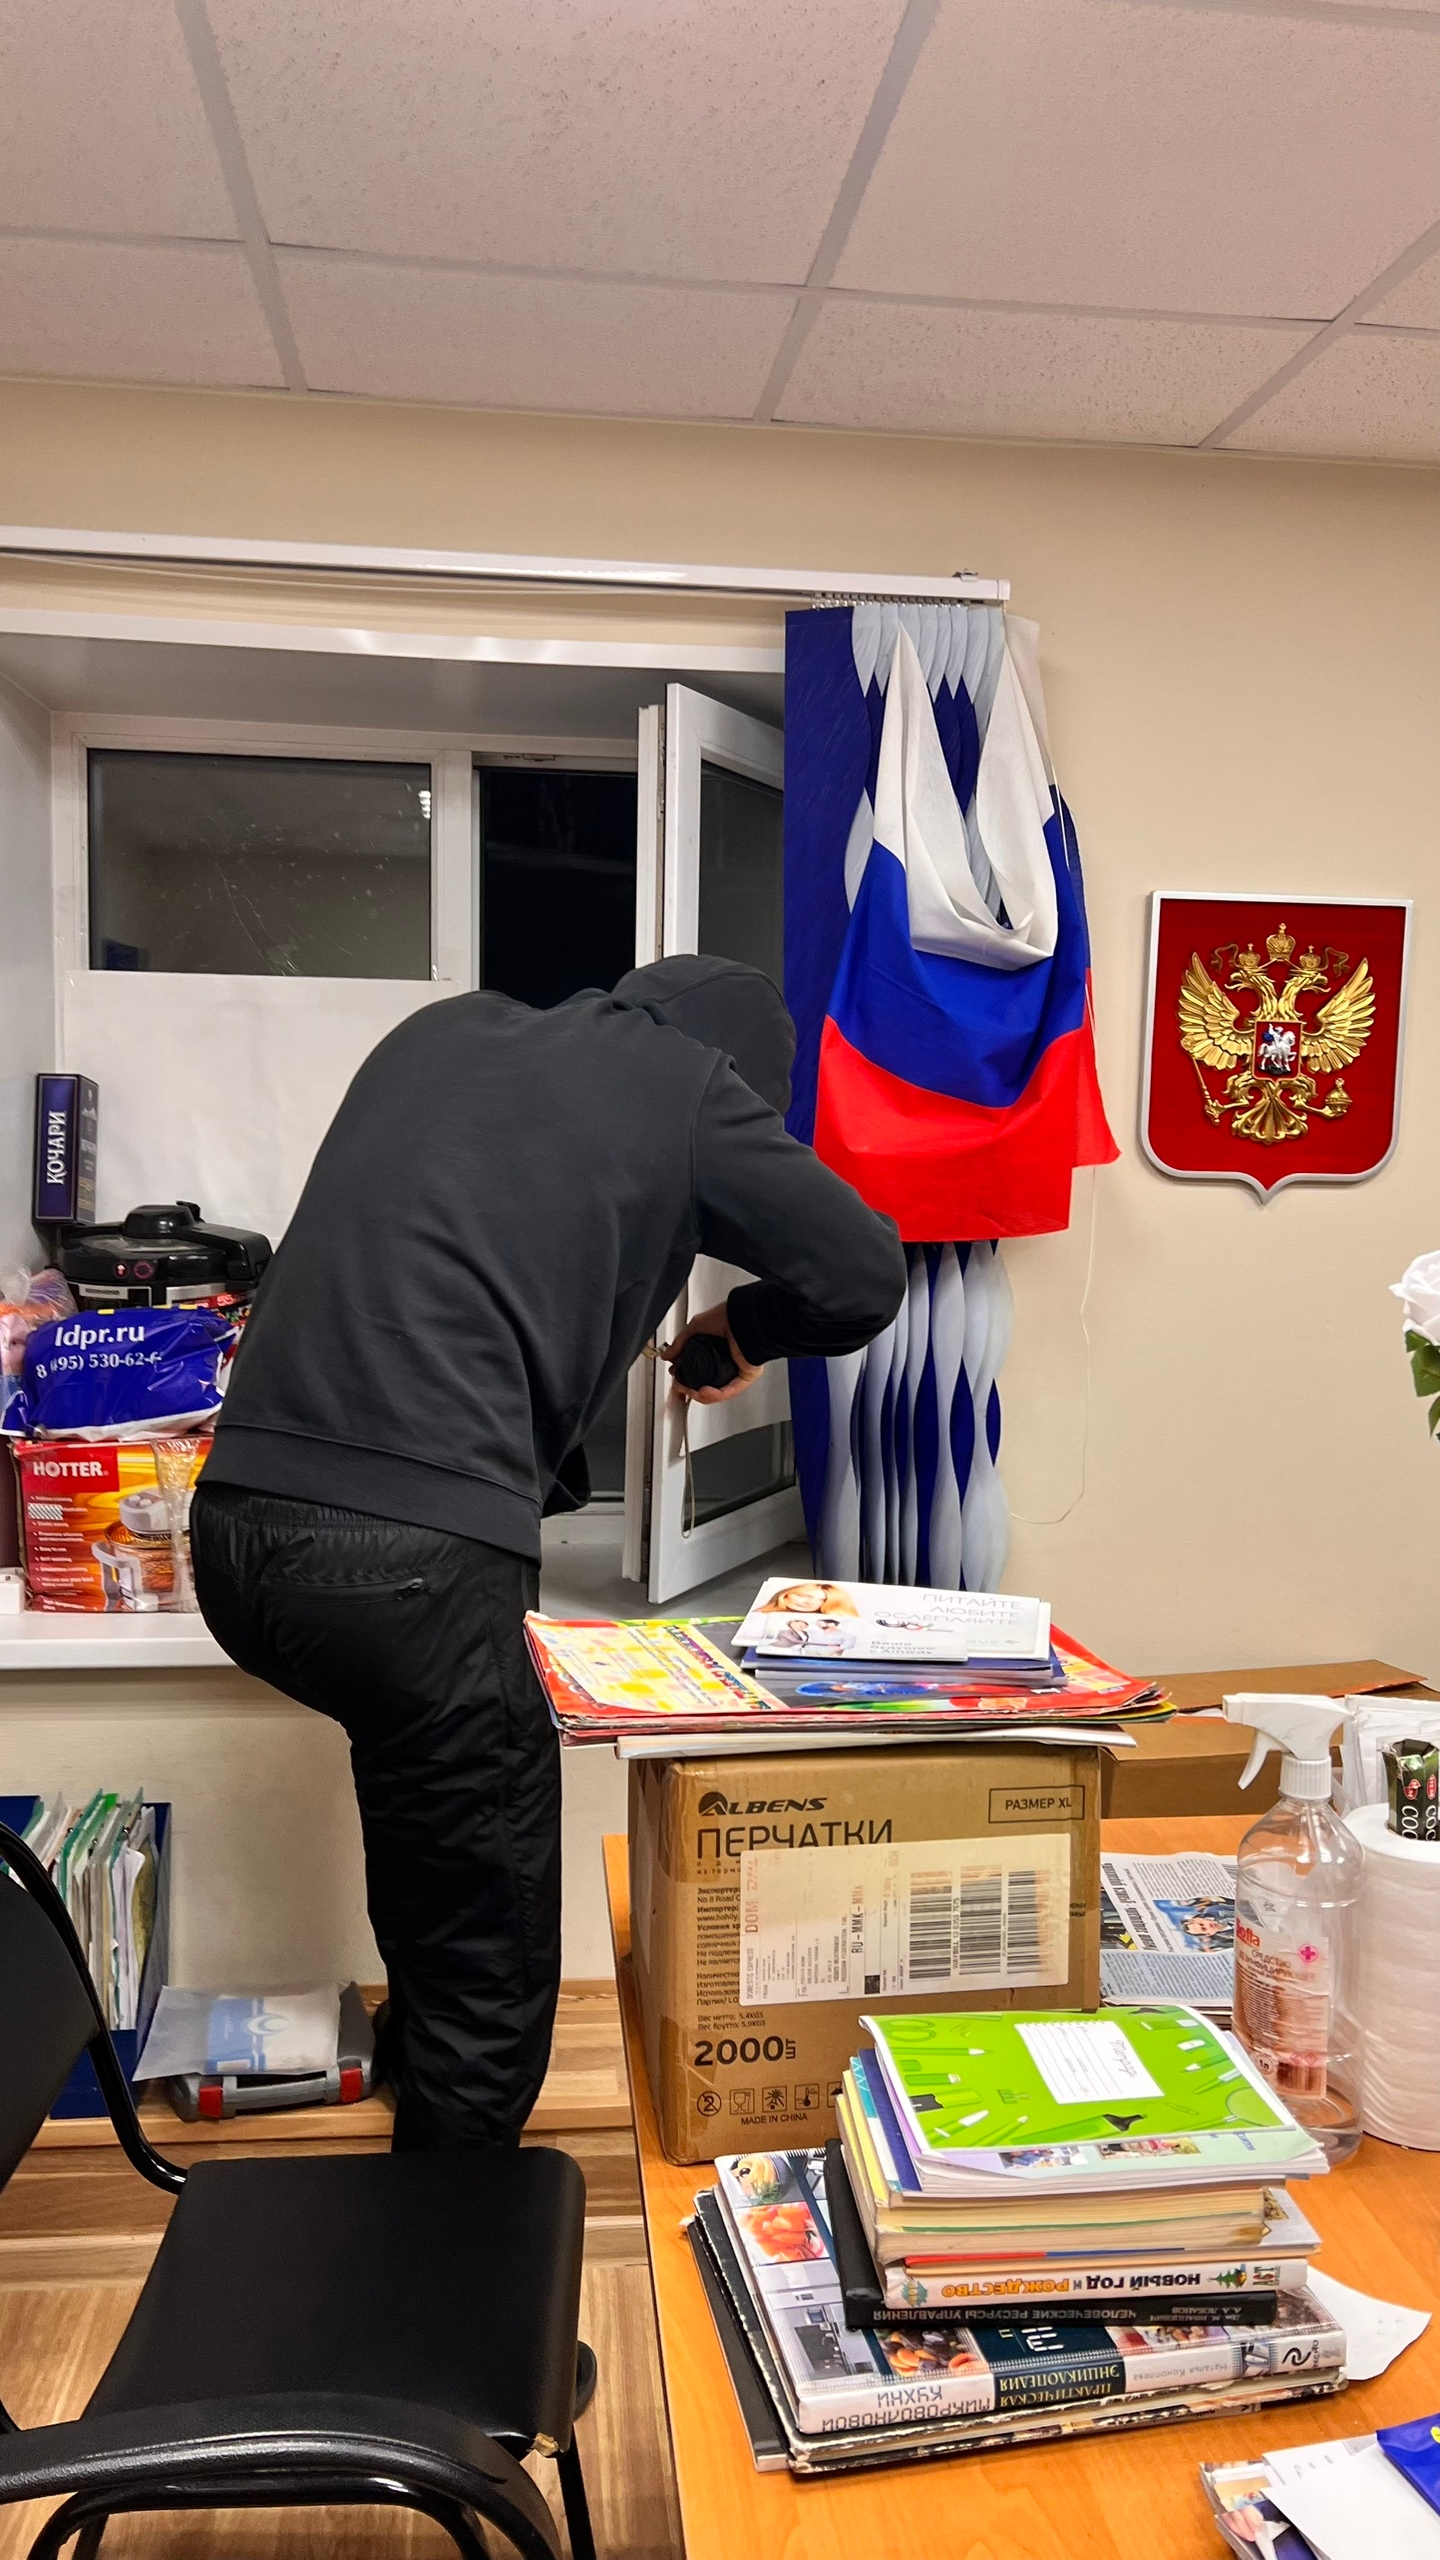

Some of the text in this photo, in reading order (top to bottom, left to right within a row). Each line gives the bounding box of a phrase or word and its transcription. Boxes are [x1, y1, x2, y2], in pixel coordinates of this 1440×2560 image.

[46, 1110, 68, 1185] КОЧАРИ
[54, 1324, 146, 1350] ldpr.ru
[35, 1364, 48, 1379] 8
[32, 1461, 103, 1478] HOTTER
[1005, 1796, 1073, 1811] РАЗМЕР XL
[697, 1818, 893, 1859] ПЕРЧАТКИ
[744, 1901, 759, 1934] DOM
[694, 2035, 784, 2067] 2000
[740, 2112, 809, 2126] MADE IN CHINA
[941, 2277, 1070, 2299] РОЖДЕСТВО
[1085, 2273, 1126, 2293] ГОД
[1129, 2272, 1201, 2293] НОВЫЙ
[873, 2308, 1137, 2322] ЧЕЛОВЕЧЕСКИЕ РЕСУРСЫ УПРАВЛЕНИЯ
[999, 2364, 1120, 2391] ЭНЦИКЛОПЕДИЯ
[1132, 2362, 1228, 2381] Наталья Коноплева
[876, 2385, 943, 2406] КУХНИ
[1000, 2383, 1112, 2407] ПРАКТИЧЕСКАЯ
[821, 2397, 991, 2433] МИКРОВОЛНОВОЙ
